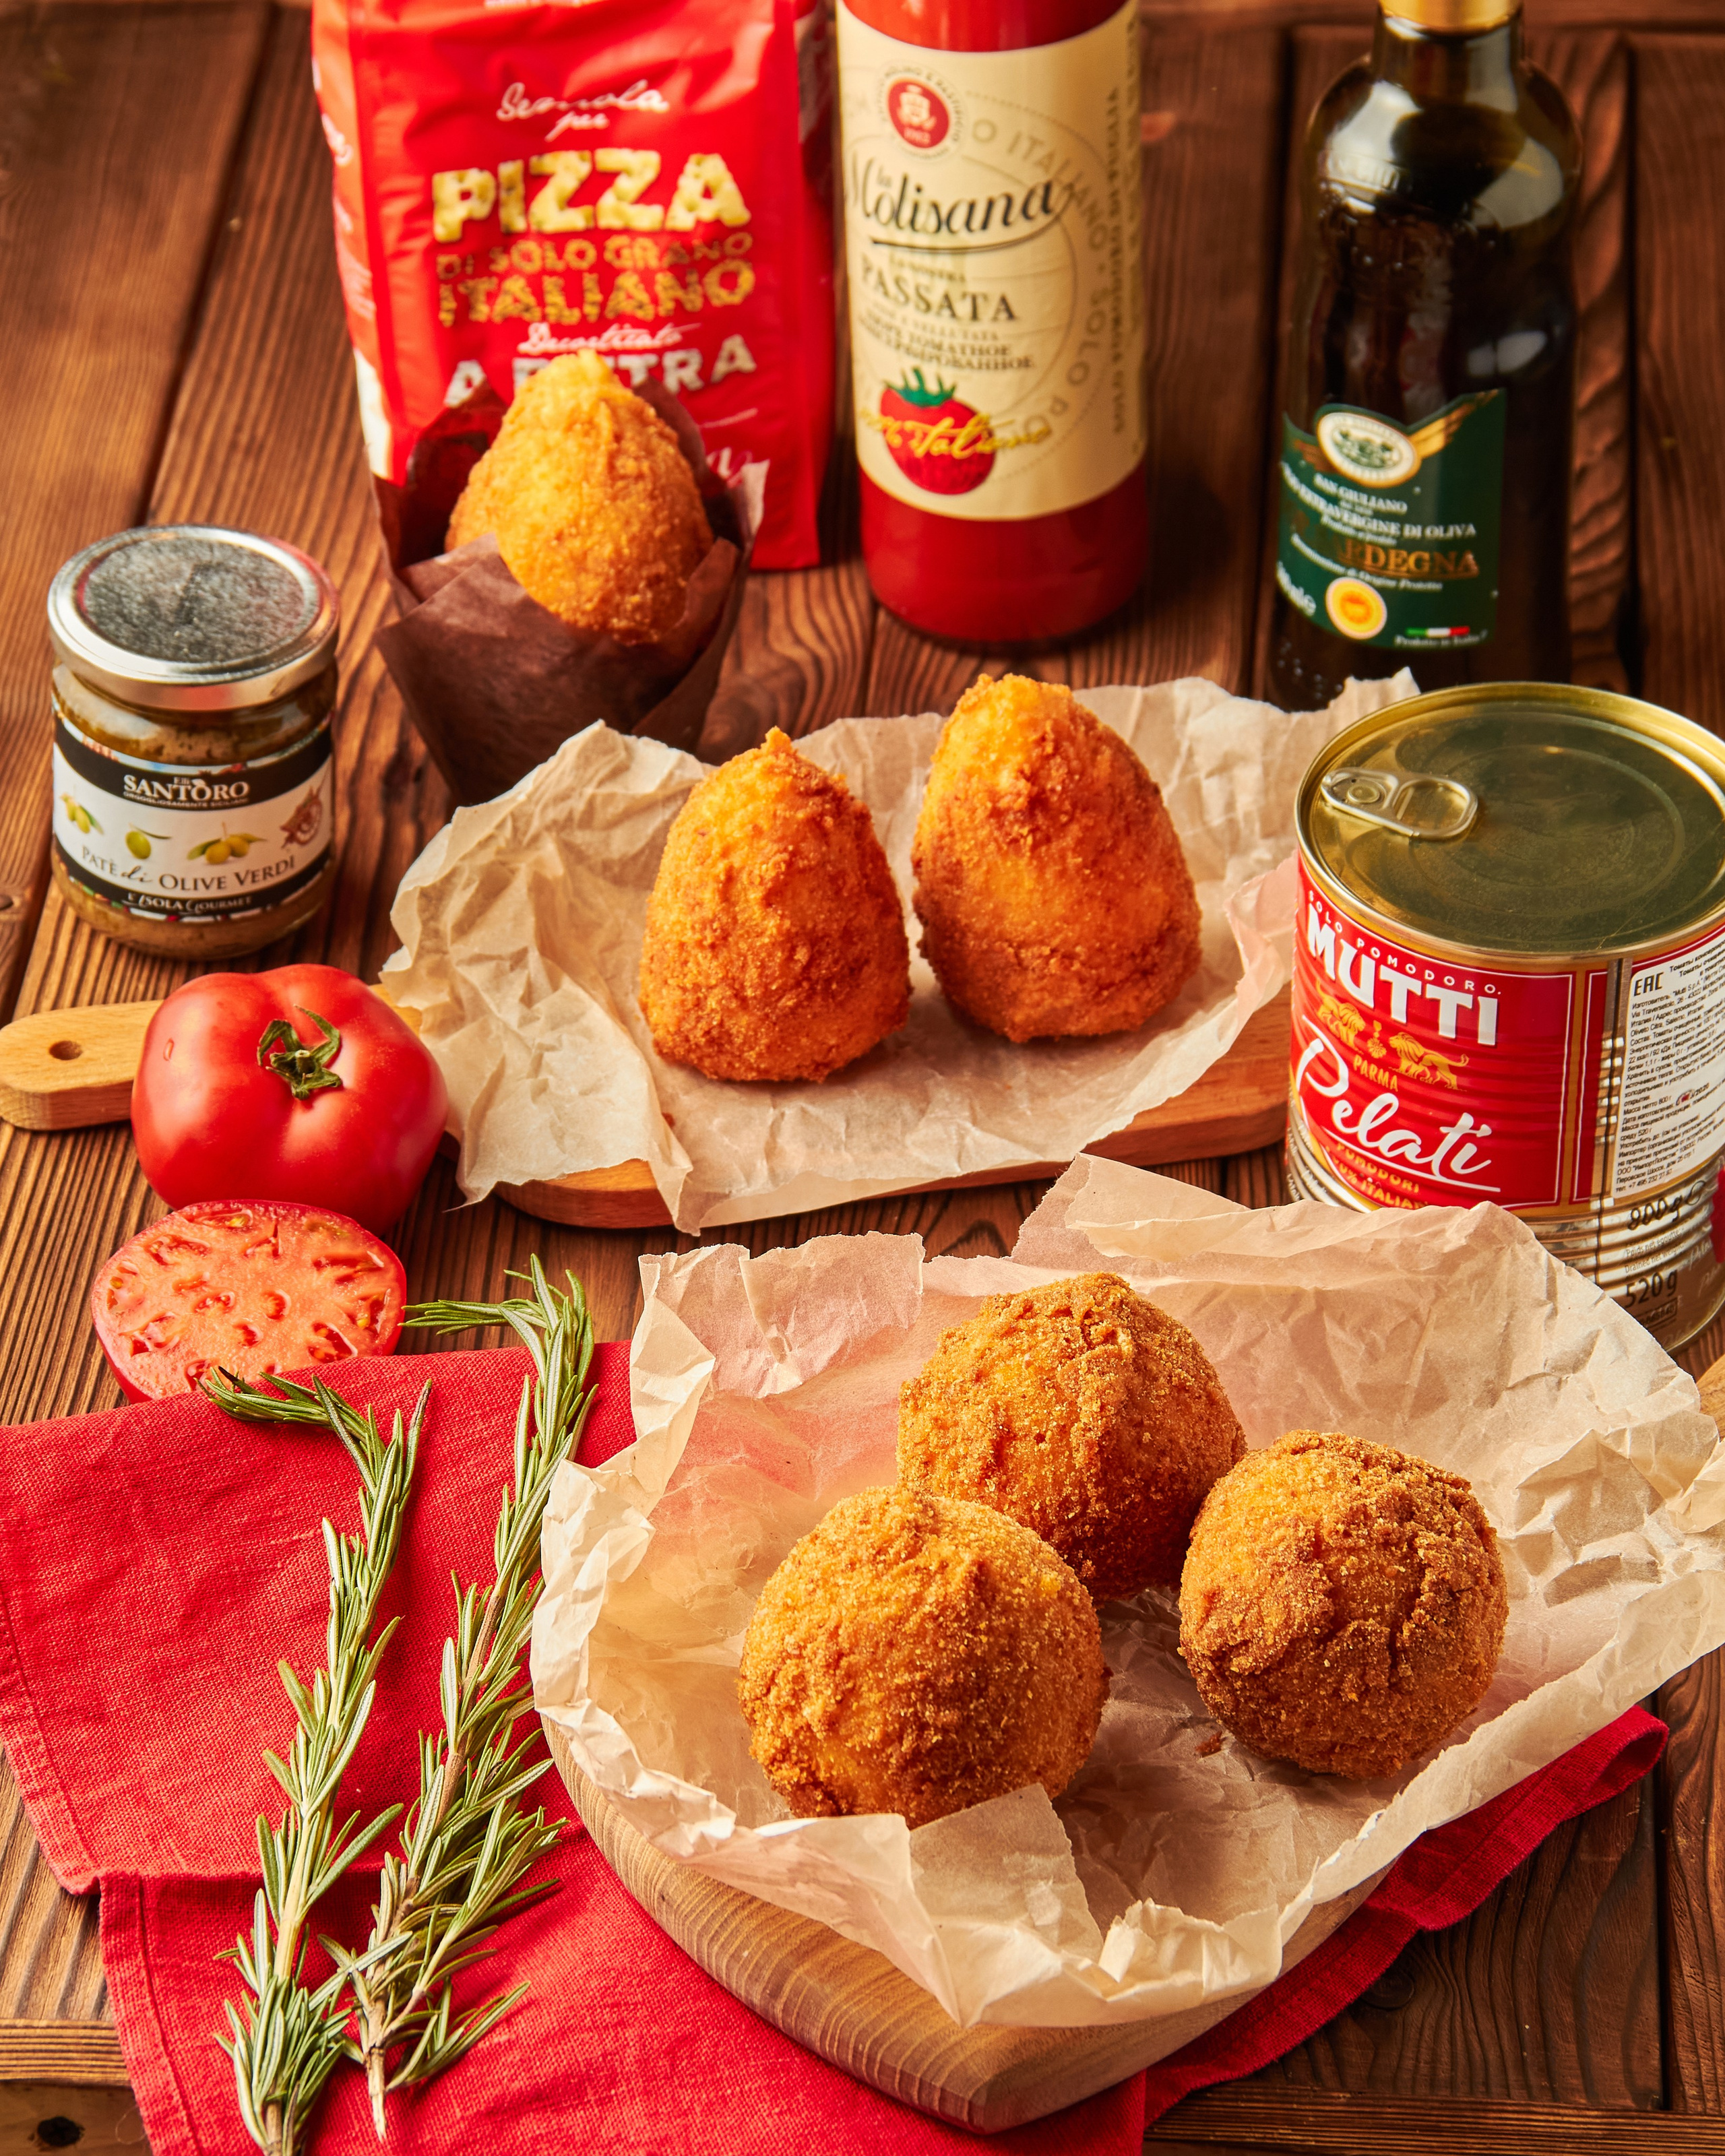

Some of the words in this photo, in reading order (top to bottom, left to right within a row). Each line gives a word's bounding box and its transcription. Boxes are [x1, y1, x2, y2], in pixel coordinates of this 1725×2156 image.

[431, 148, 751, 243] PIZZA
[848, 150, 1056, 236] Molisana
[436, 252, 474, 280] DI
[489, 237, 596, 275] SOLO
[604, 232, 755, 270] GRANO
[439, 260, 755, 327] ITALIANO
[860, 250, 1020, 323] PASSATA
[443, 358, 487, 409] A
[512, 334, 758, 396] PTRA
[1403, 523, 1422, 539] DI
[1424, 521, 1477, 540] OLIVA
[123, 773, 250, 802] SANTORO
[158, 873, 227, 891] OLIVE
[233, 854, 296, 887] VERDI
[1309, 889, 1343, 934] SOLO
[1307, 901, 1499, 1047] MUTTI
[1633, 971, 1664, 996] EAC
[1295, 1015, 1494, 1179] Pelati
[1352, 1054, 1400, 1093] PARMA
[1337, 1143, 1419, 1193] POMODORI
